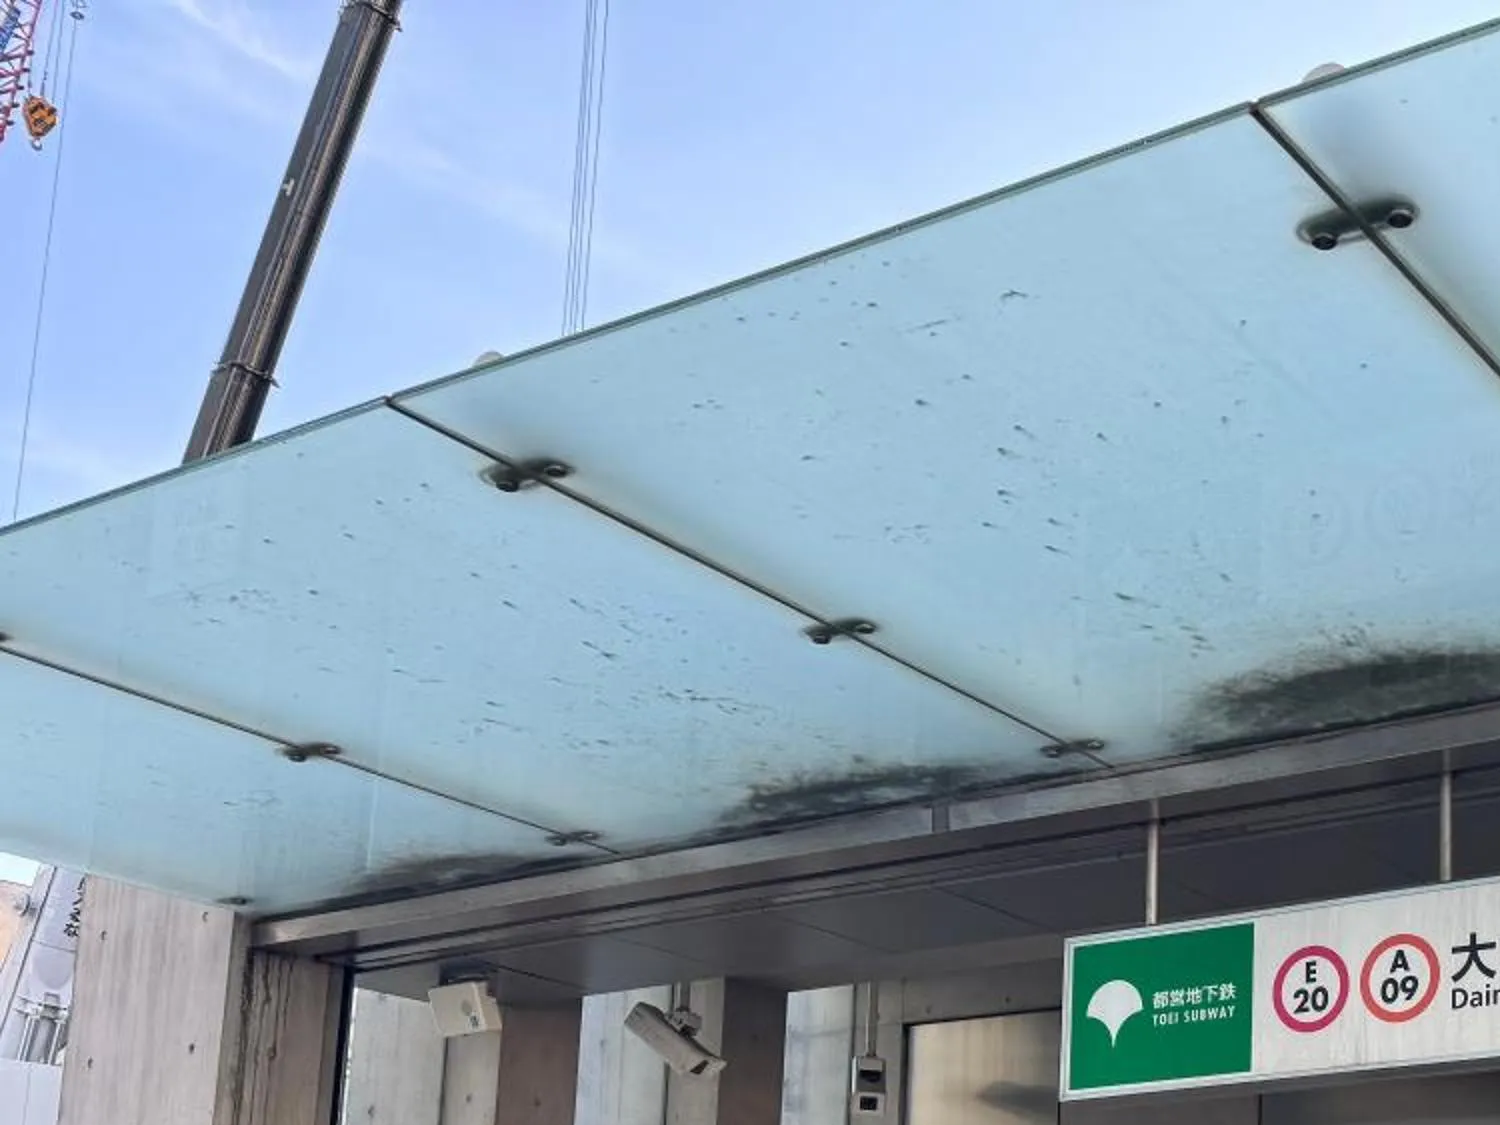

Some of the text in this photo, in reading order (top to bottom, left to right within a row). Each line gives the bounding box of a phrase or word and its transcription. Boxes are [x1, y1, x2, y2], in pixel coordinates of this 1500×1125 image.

[1305, 960, 1318, 983] E
[1389, 949, 1410, 974] A
[1152, 983, 1237, 1010] 都営地下鉄
[1293, 985, 1329, 1014] 20
[1380, 975, 1419, 1004] 09
[1152, 1005, 1236, 1027] TOEI SUBWAY
